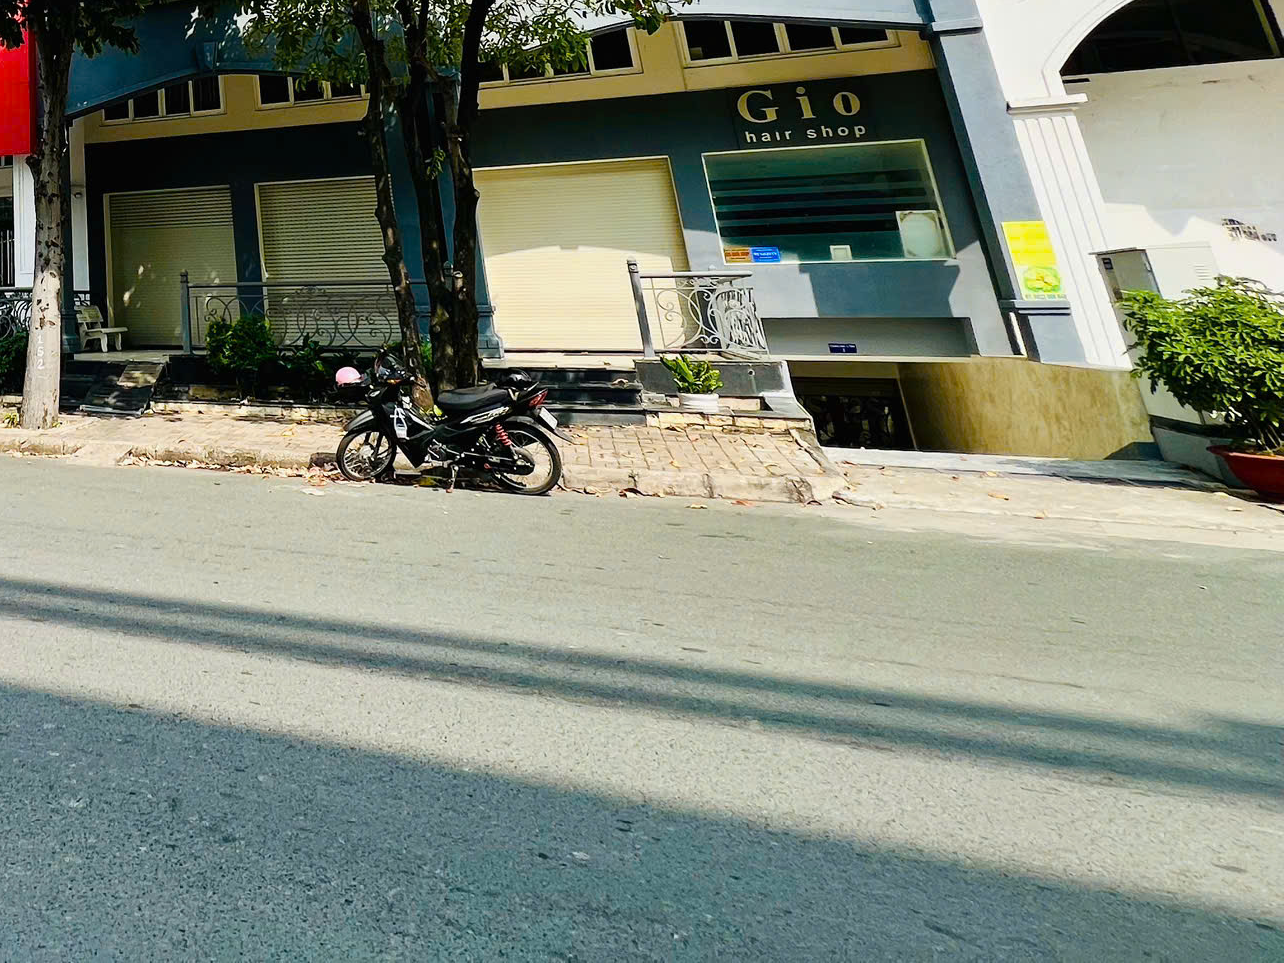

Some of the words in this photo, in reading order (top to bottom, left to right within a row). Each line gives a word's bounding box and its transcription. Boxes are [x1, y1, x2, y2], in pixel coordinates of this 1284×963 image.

[737, 86, 861, 124] Gio
[744, 130, 792, 143] hair
[806, 125, 866, 139] shop
